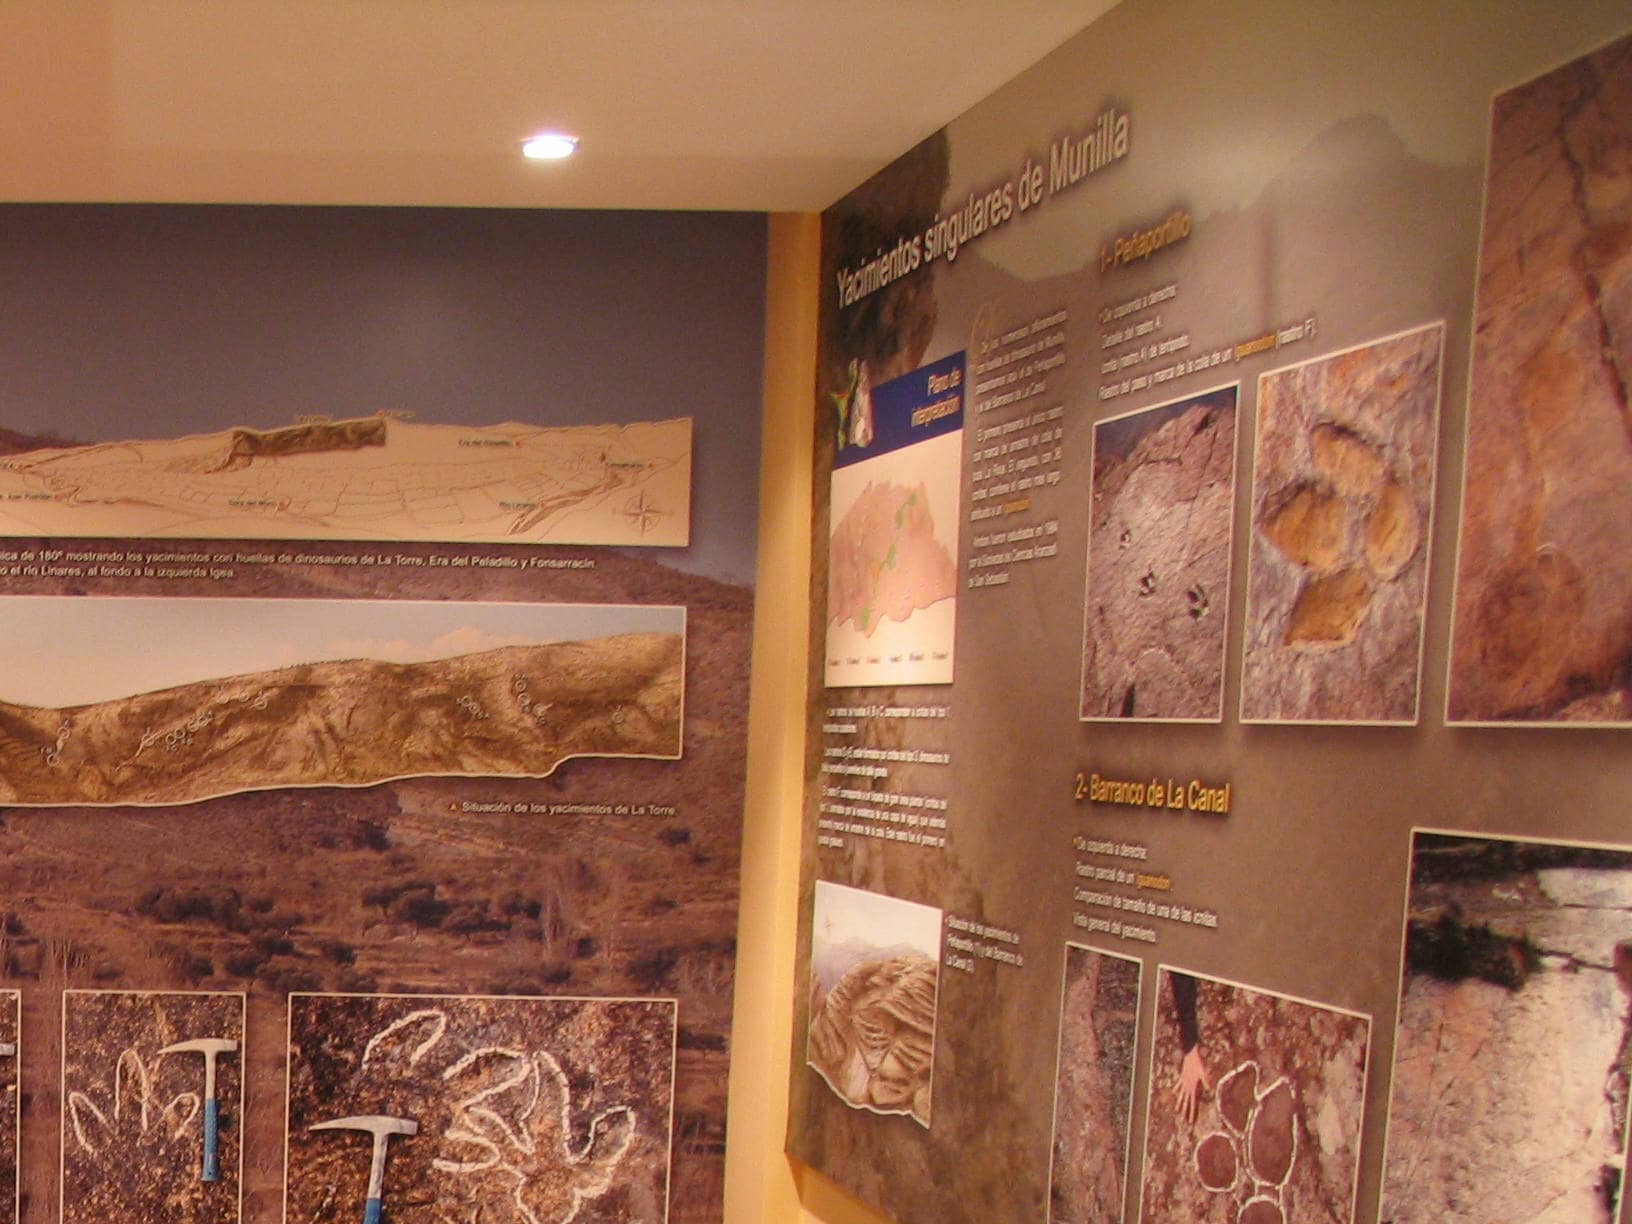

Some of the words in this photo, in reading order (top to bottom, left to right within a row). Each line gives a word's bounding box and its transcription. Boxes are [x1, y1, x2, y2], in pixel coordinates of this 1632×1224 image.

[837, 234, 921, 310] Yacimientos
[924, 182, 1013, 262] singulares
[1018, 159, 1044, 211] de
[1049, 108, 1129, 194] Munilla
[1090, 774, 1145, 805] Barranco
[1147, 777, 1164, 807] de
[1167, 779, 1184, 809] La
[1188, 779, 1231, 813] Canal
